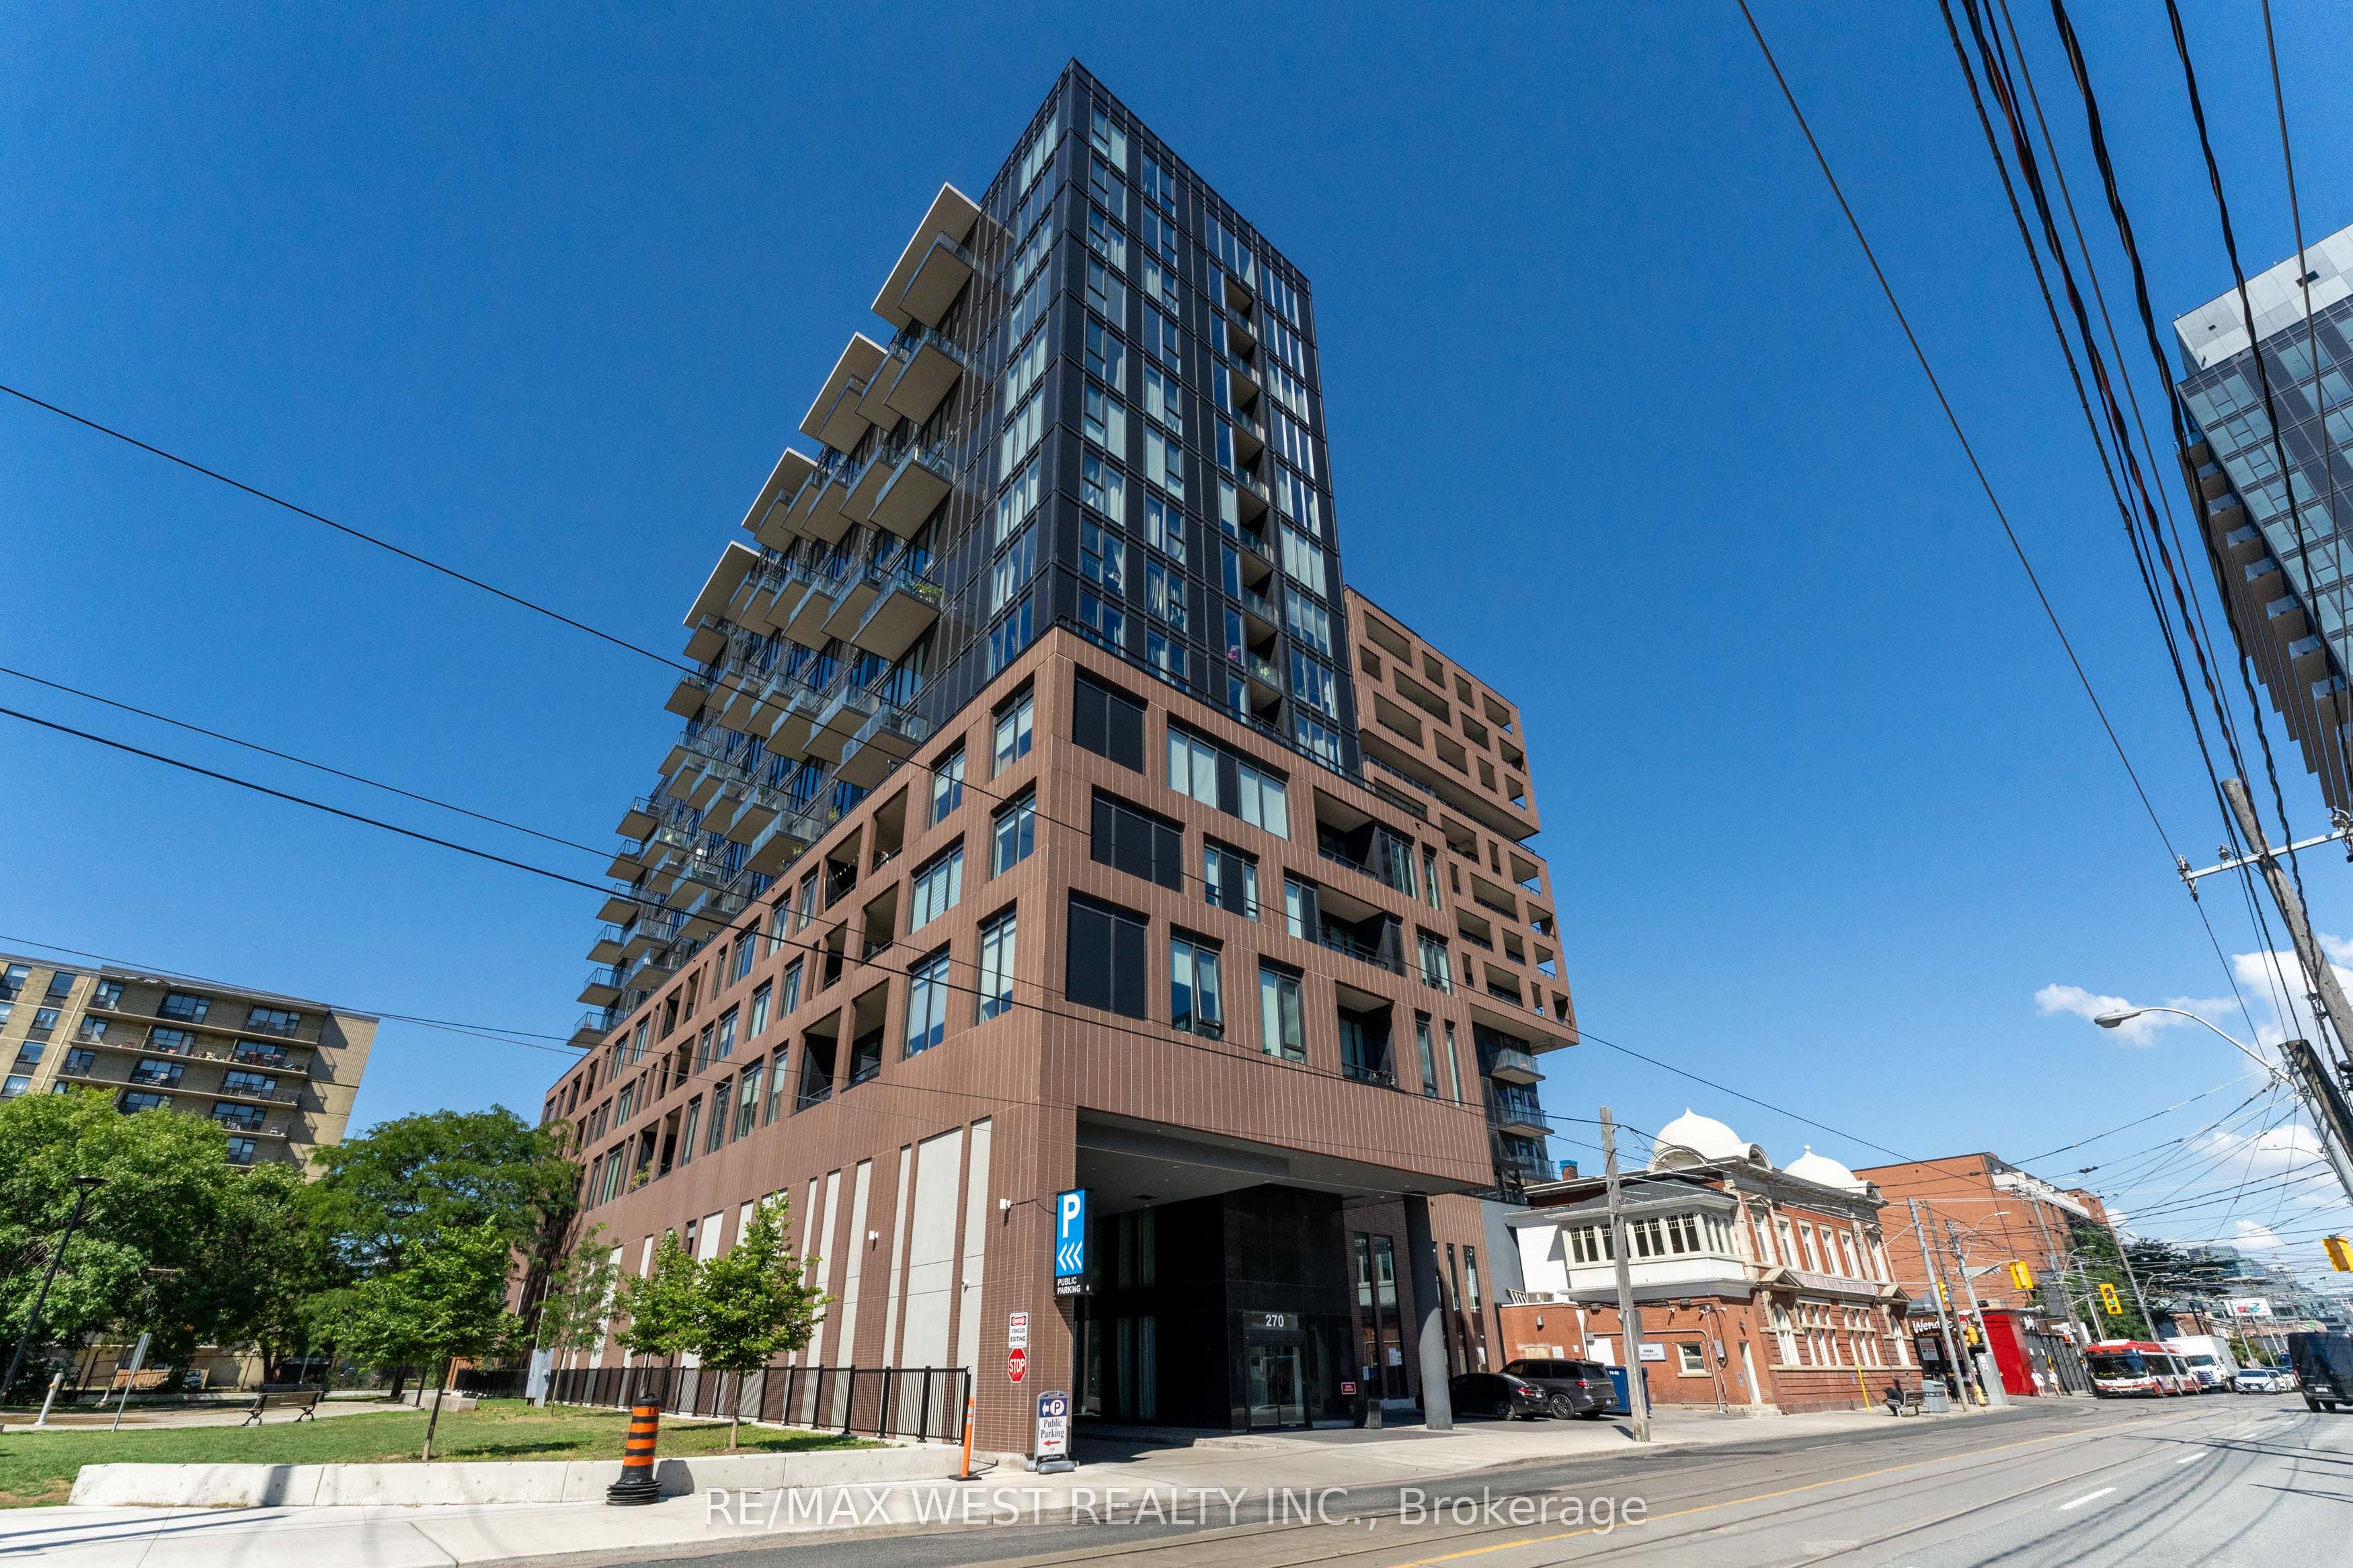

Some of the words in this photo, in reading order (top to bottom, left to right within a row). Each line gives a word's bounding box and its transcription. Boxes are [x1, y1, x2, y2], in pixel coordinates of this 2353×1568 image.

[1062, 1194, 1081, 1238] P
[1058, 1276, 1077, 1286] PUBLIC
[1057, 1285, 1081, 1295] PARKING
[1265, 1314, 1284, 1327] 270
[1009, 1358, 1025, 1373] STOP
[1054, 1401, 1061, 1414] P
[1043, 1418, 1063, 1429] Public
[1040, 1429, 1064, 1440] Parking
